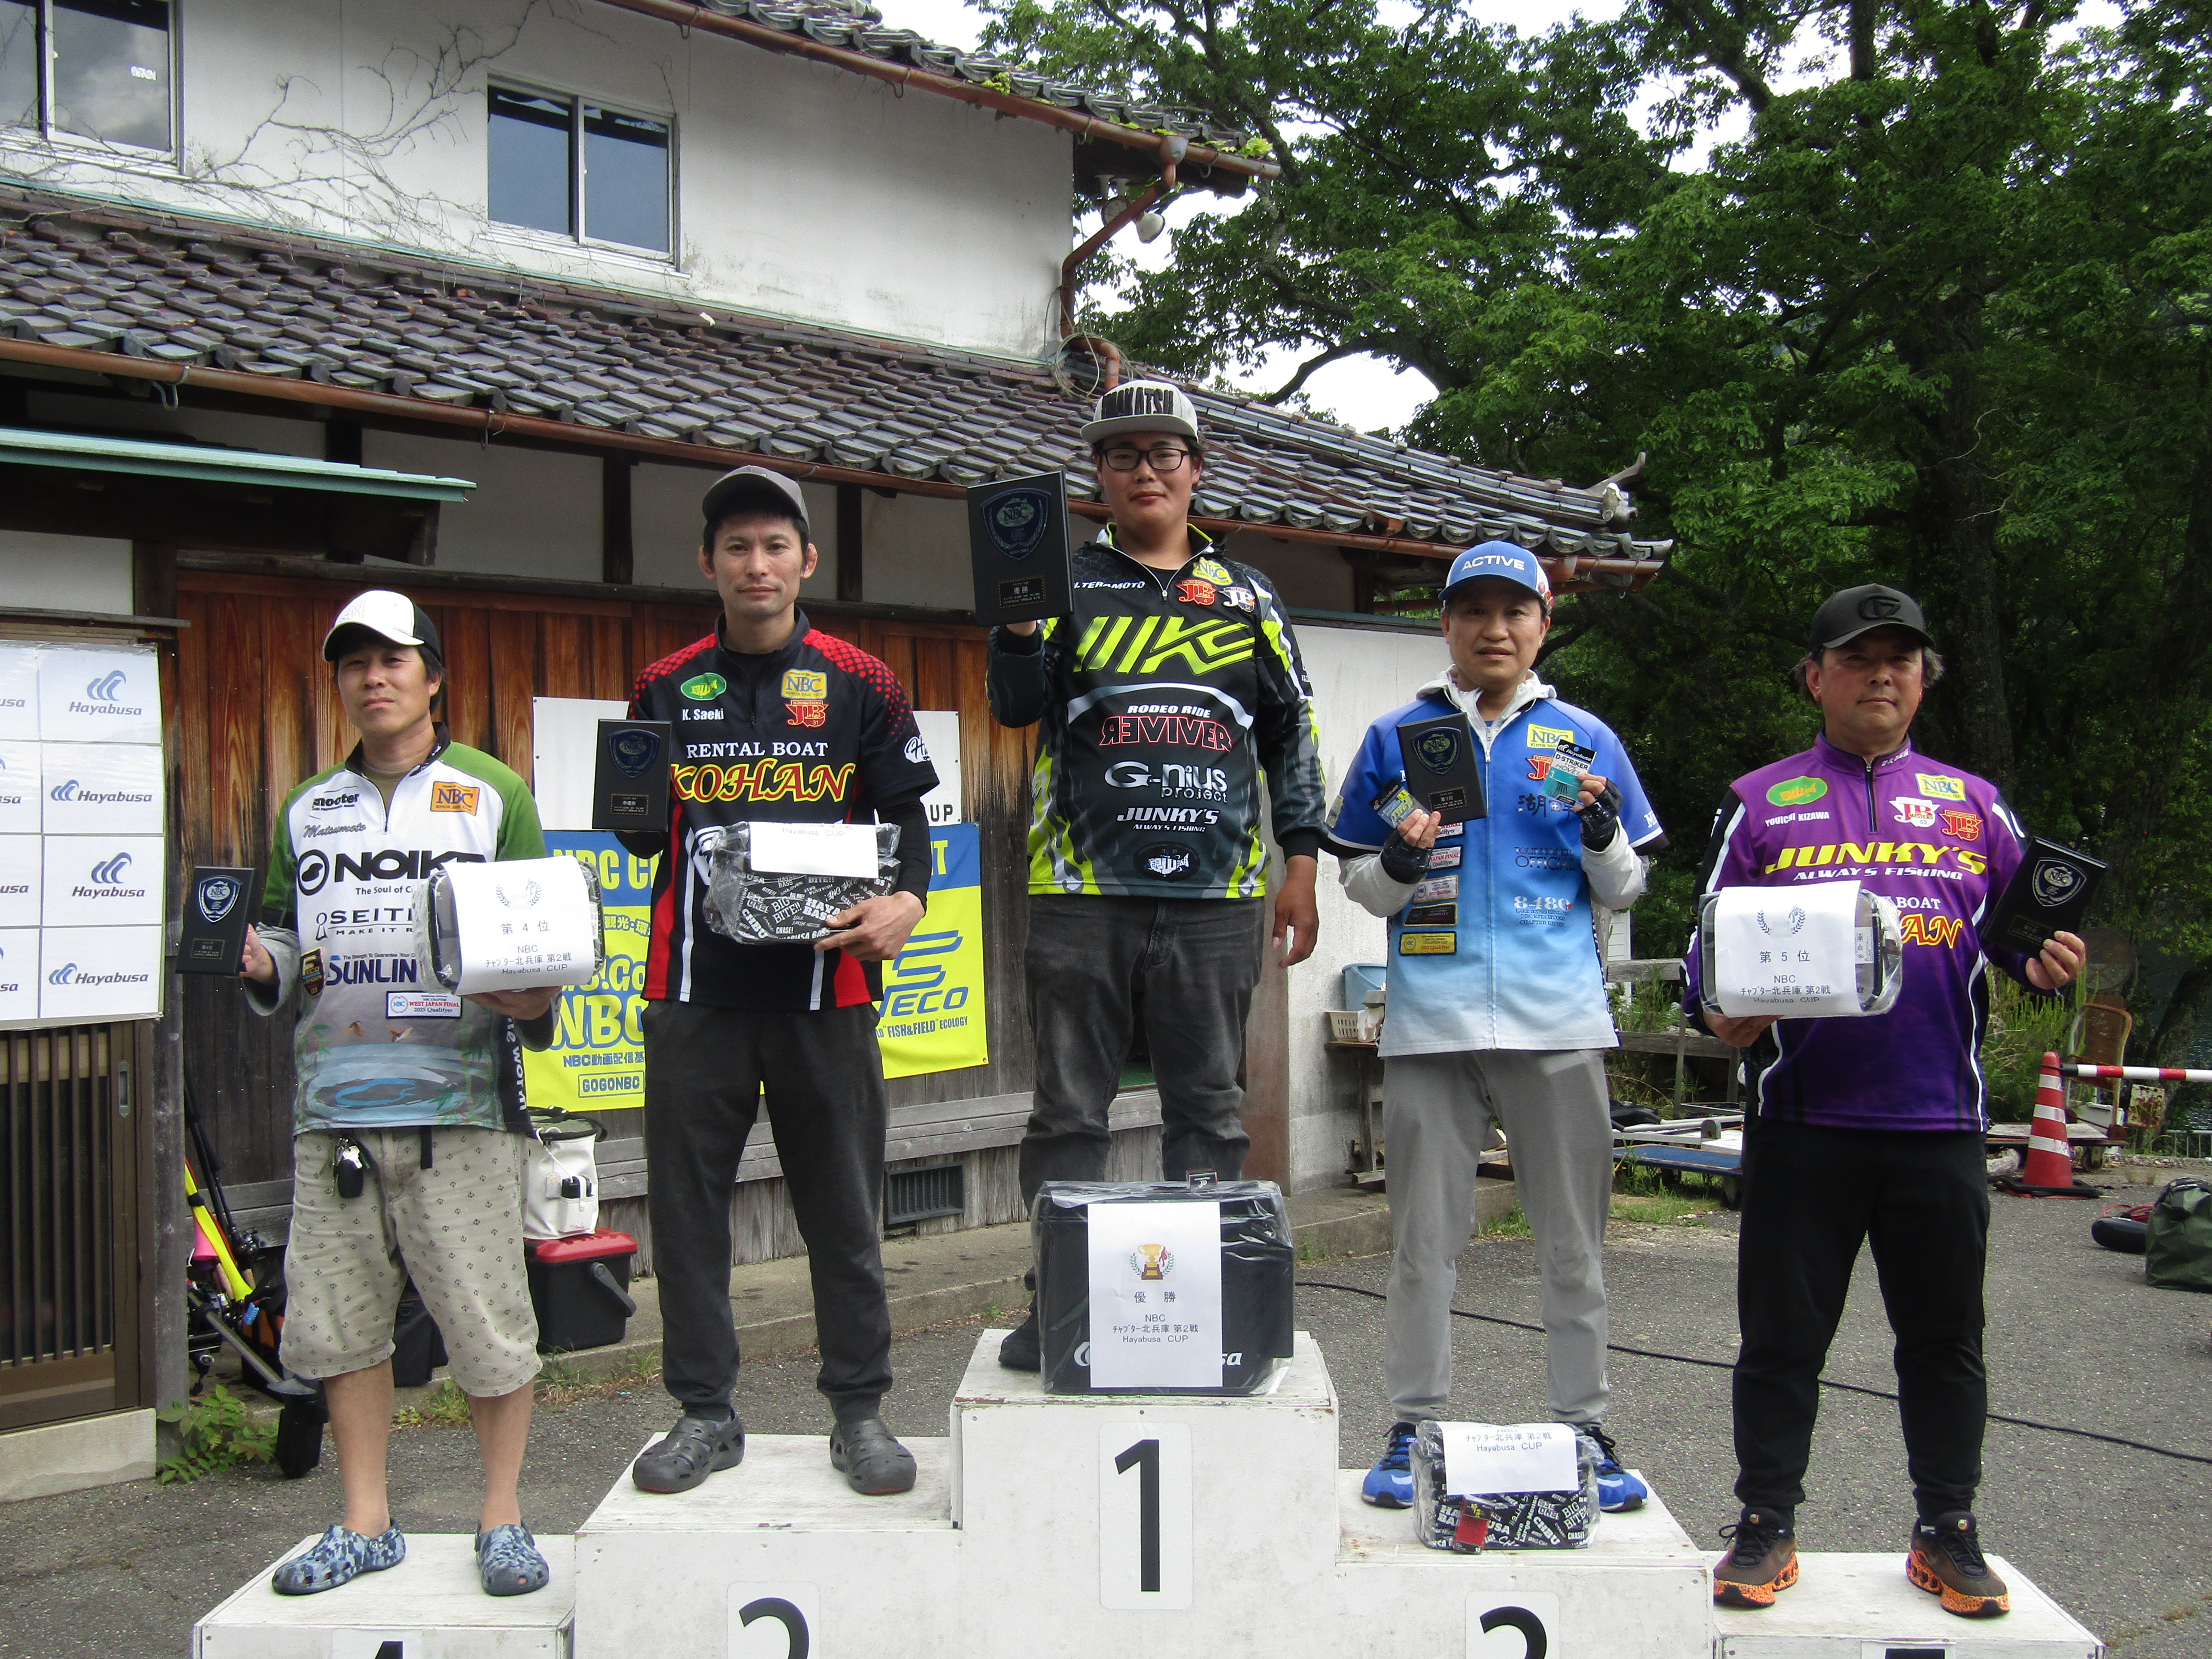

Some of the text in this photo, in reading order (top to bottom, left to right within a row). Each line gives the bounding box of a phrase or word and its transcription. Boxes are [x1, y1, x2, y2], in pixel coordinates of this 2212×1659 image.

[1197, 562, 1228, 579] NBC
[1461, 555, 1525, 572] ACTIVE
[1179, 584, 1215, 602] JB
[786, 676, 822, 693] NBC
[69, 702, 143, 715] Hayabusa
[682, 708, 724, 721] K. Saeki
[787, 705, 826, 725] JB
[1127, 705, 1211, 718] RODEO RIDE
[687, 741, 828, 758] RENTAL BOAT
[1565, 747, 1592, 762] Hayabusa
[1555, 754, 1589, 771] D-STRIKER
[671, 757, 856, 803] KOHAN
[1105, 761, 1228, 792] G-nius
[1922, 779, 1959, 793] NBC
[77, 790, 152, 803] Hayabusa
[437, 788, 474, 808] NBC
[1161, 787, 1228, 803] project
[1117, 807, 1219, 824] JUNKY'S
[1765, 811, 1830, 827] YOUICHI KIZAWA
[303, 823, 366, 838] Matsumoto
[782, 827, 819, 836] Hayabusa
[1942, 816, 1979, 835] JB
[334, 850, 487, 882] NOIK
[1515, 855, 1576, 871] OFFICIAL
[1765, 842, 1987, 875] JUNKY'S
[1793, 867, 1963, 881] ALWAYS FISHING
[72, 886, 146, 899] Hayabusa
[373, 886, 392, 894] Soul
[771, 896, 790, 912] BIG
[1896, 896, 1941, 910] BOAT
[772, 902, 802, 924] BITE!!
[742, 908, 769, 939] CHBU
[517, 945, 538, 954] NBC
[547, 952, 572, 962] 第2戦
[326, 955, 417, 986] SUNLIN
[547, 964, 568, 972] CUP
[75, 972, 149, 986] Hayabusa
[1773, 975, 1796, 983] NBC
[1805, 984, 1831, 995] 第2戦
[939, 1016, 968, 1030] ECOLOGY
[582, 1075, 641, 1093] GOGONBC
[1134, 1291, 1176, 1304] 優勝
[1144, 1314, 1166, 1322] NBC
[1173, 1324, 1199, 1334] 第2戦
[1122, 1334, 1188, 1344] Hayabusa CUP
[1526, 1432, 1552, 1440] 第2戦
[1477, 1442, 1543, 1452] Hayabusa CUP
[1115, 1439, 1160, 1592] 1
[1562, 1501, 1580, 1519] BIG
[1563, 1505, 1589, 1530] BITE!!
[1519, 1495, 1539, 1542] Large Mouse
[1514, 1523, 1524, 1540] Love
[1533, 1516, 1561, 1545] CHBU
